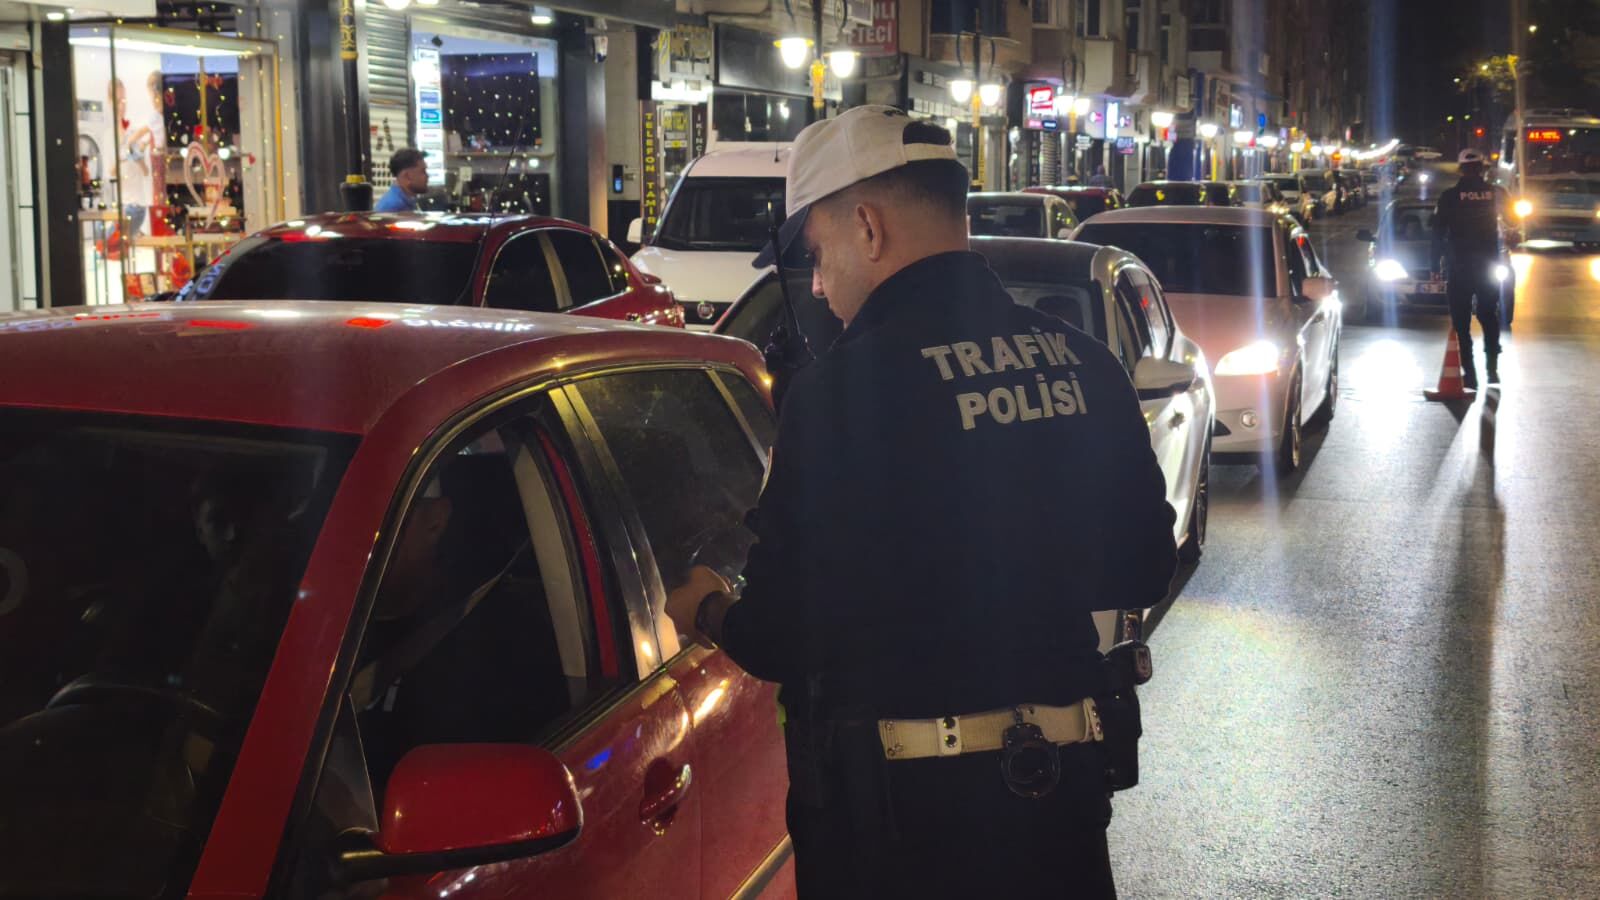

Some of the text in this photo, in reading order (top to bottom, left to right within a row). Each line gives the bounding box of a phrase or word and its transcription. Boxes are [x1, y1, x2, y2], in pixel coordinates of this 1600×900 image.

[645, 112, 656, 172] TELEFON
[921, 326, 1083, 380] TRAFİK
[956, 371, 1088, 430] POLİSİ
